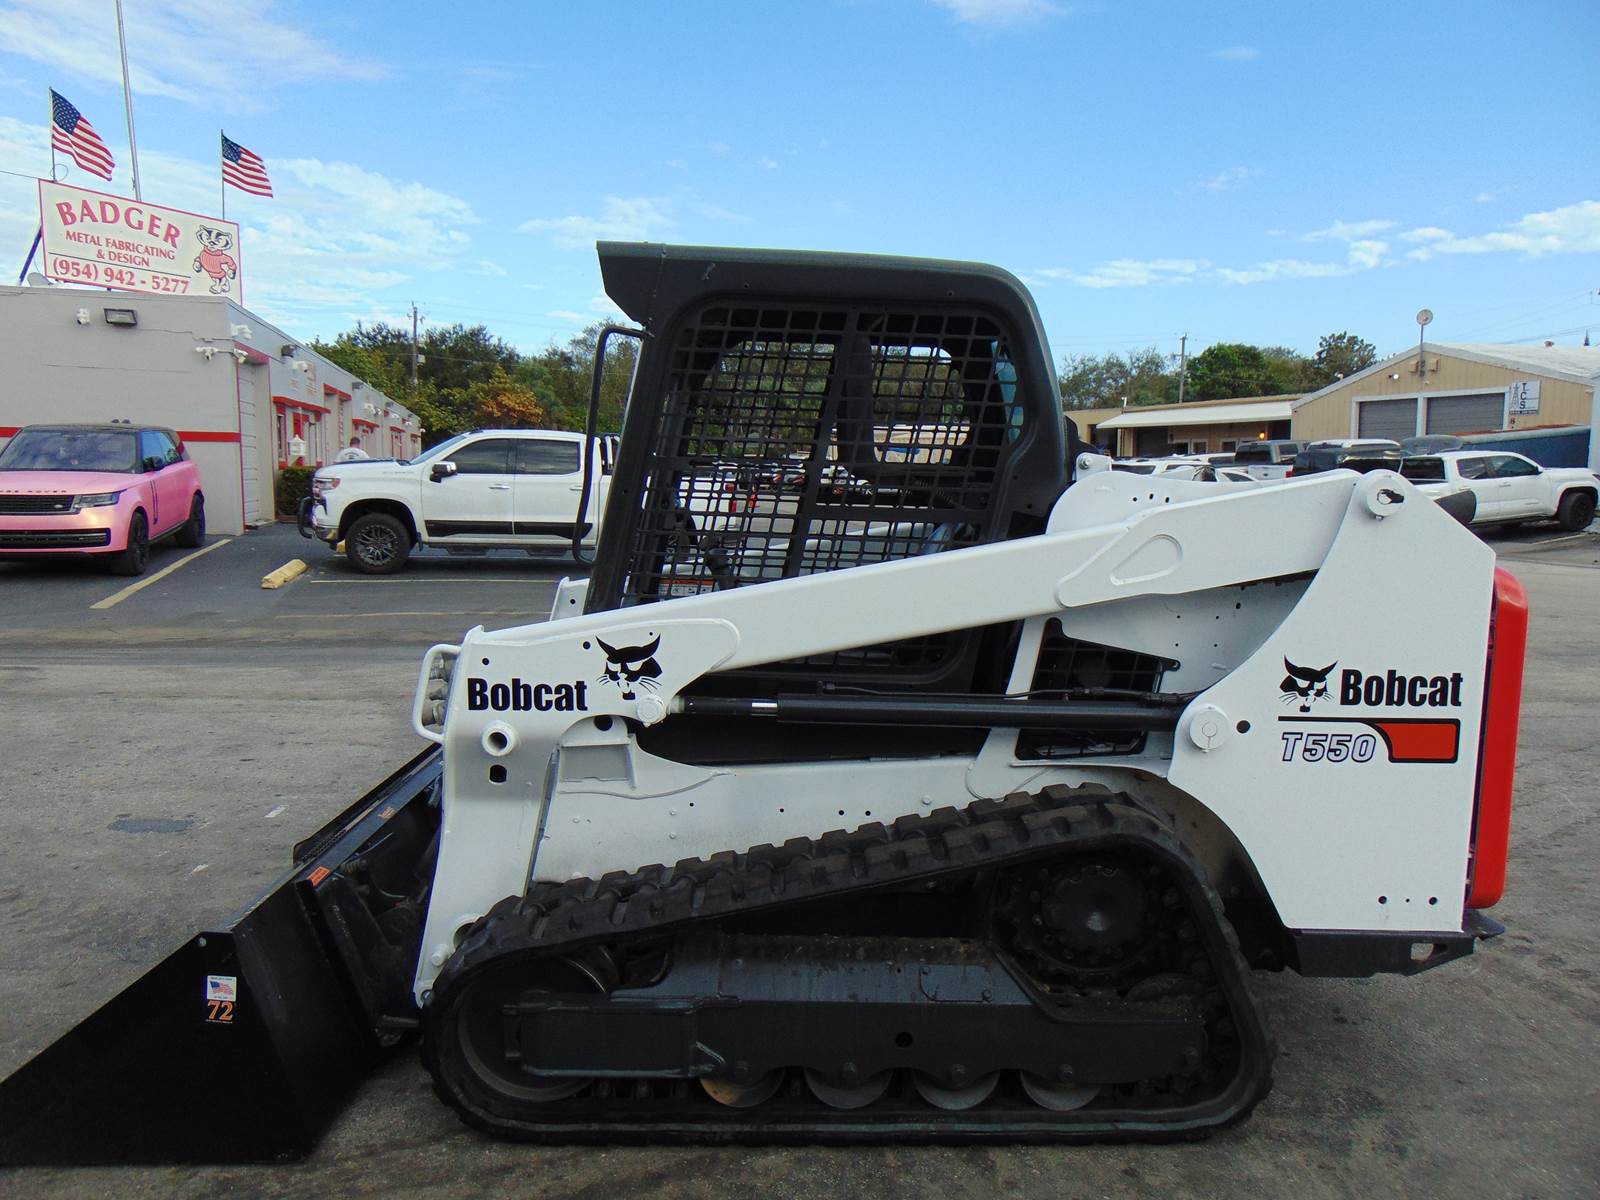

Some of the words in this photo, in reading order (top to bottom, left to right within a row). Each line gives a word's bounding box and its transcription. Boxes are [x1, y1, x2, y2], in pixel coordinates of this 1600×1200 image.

[56, 200, 181, 249] BADGER
[65, 230, 103, 247] METAL
[105, 238, 176, 260] FABRICATING
[96, 249, 105, 260] &
[108, 251, 150, 267] DESIGN
[53, 256, 99, 281] (954)
[104, 267, 136, 286] 942
[151, 275, 190, 294] 5277
[467, 677, 589, 712] Bobcat
[1339, 669, 1464, 708] Bobcat
[1281, 731, 1377, 763] T550
[207, 1000, 234, 1021] 72
